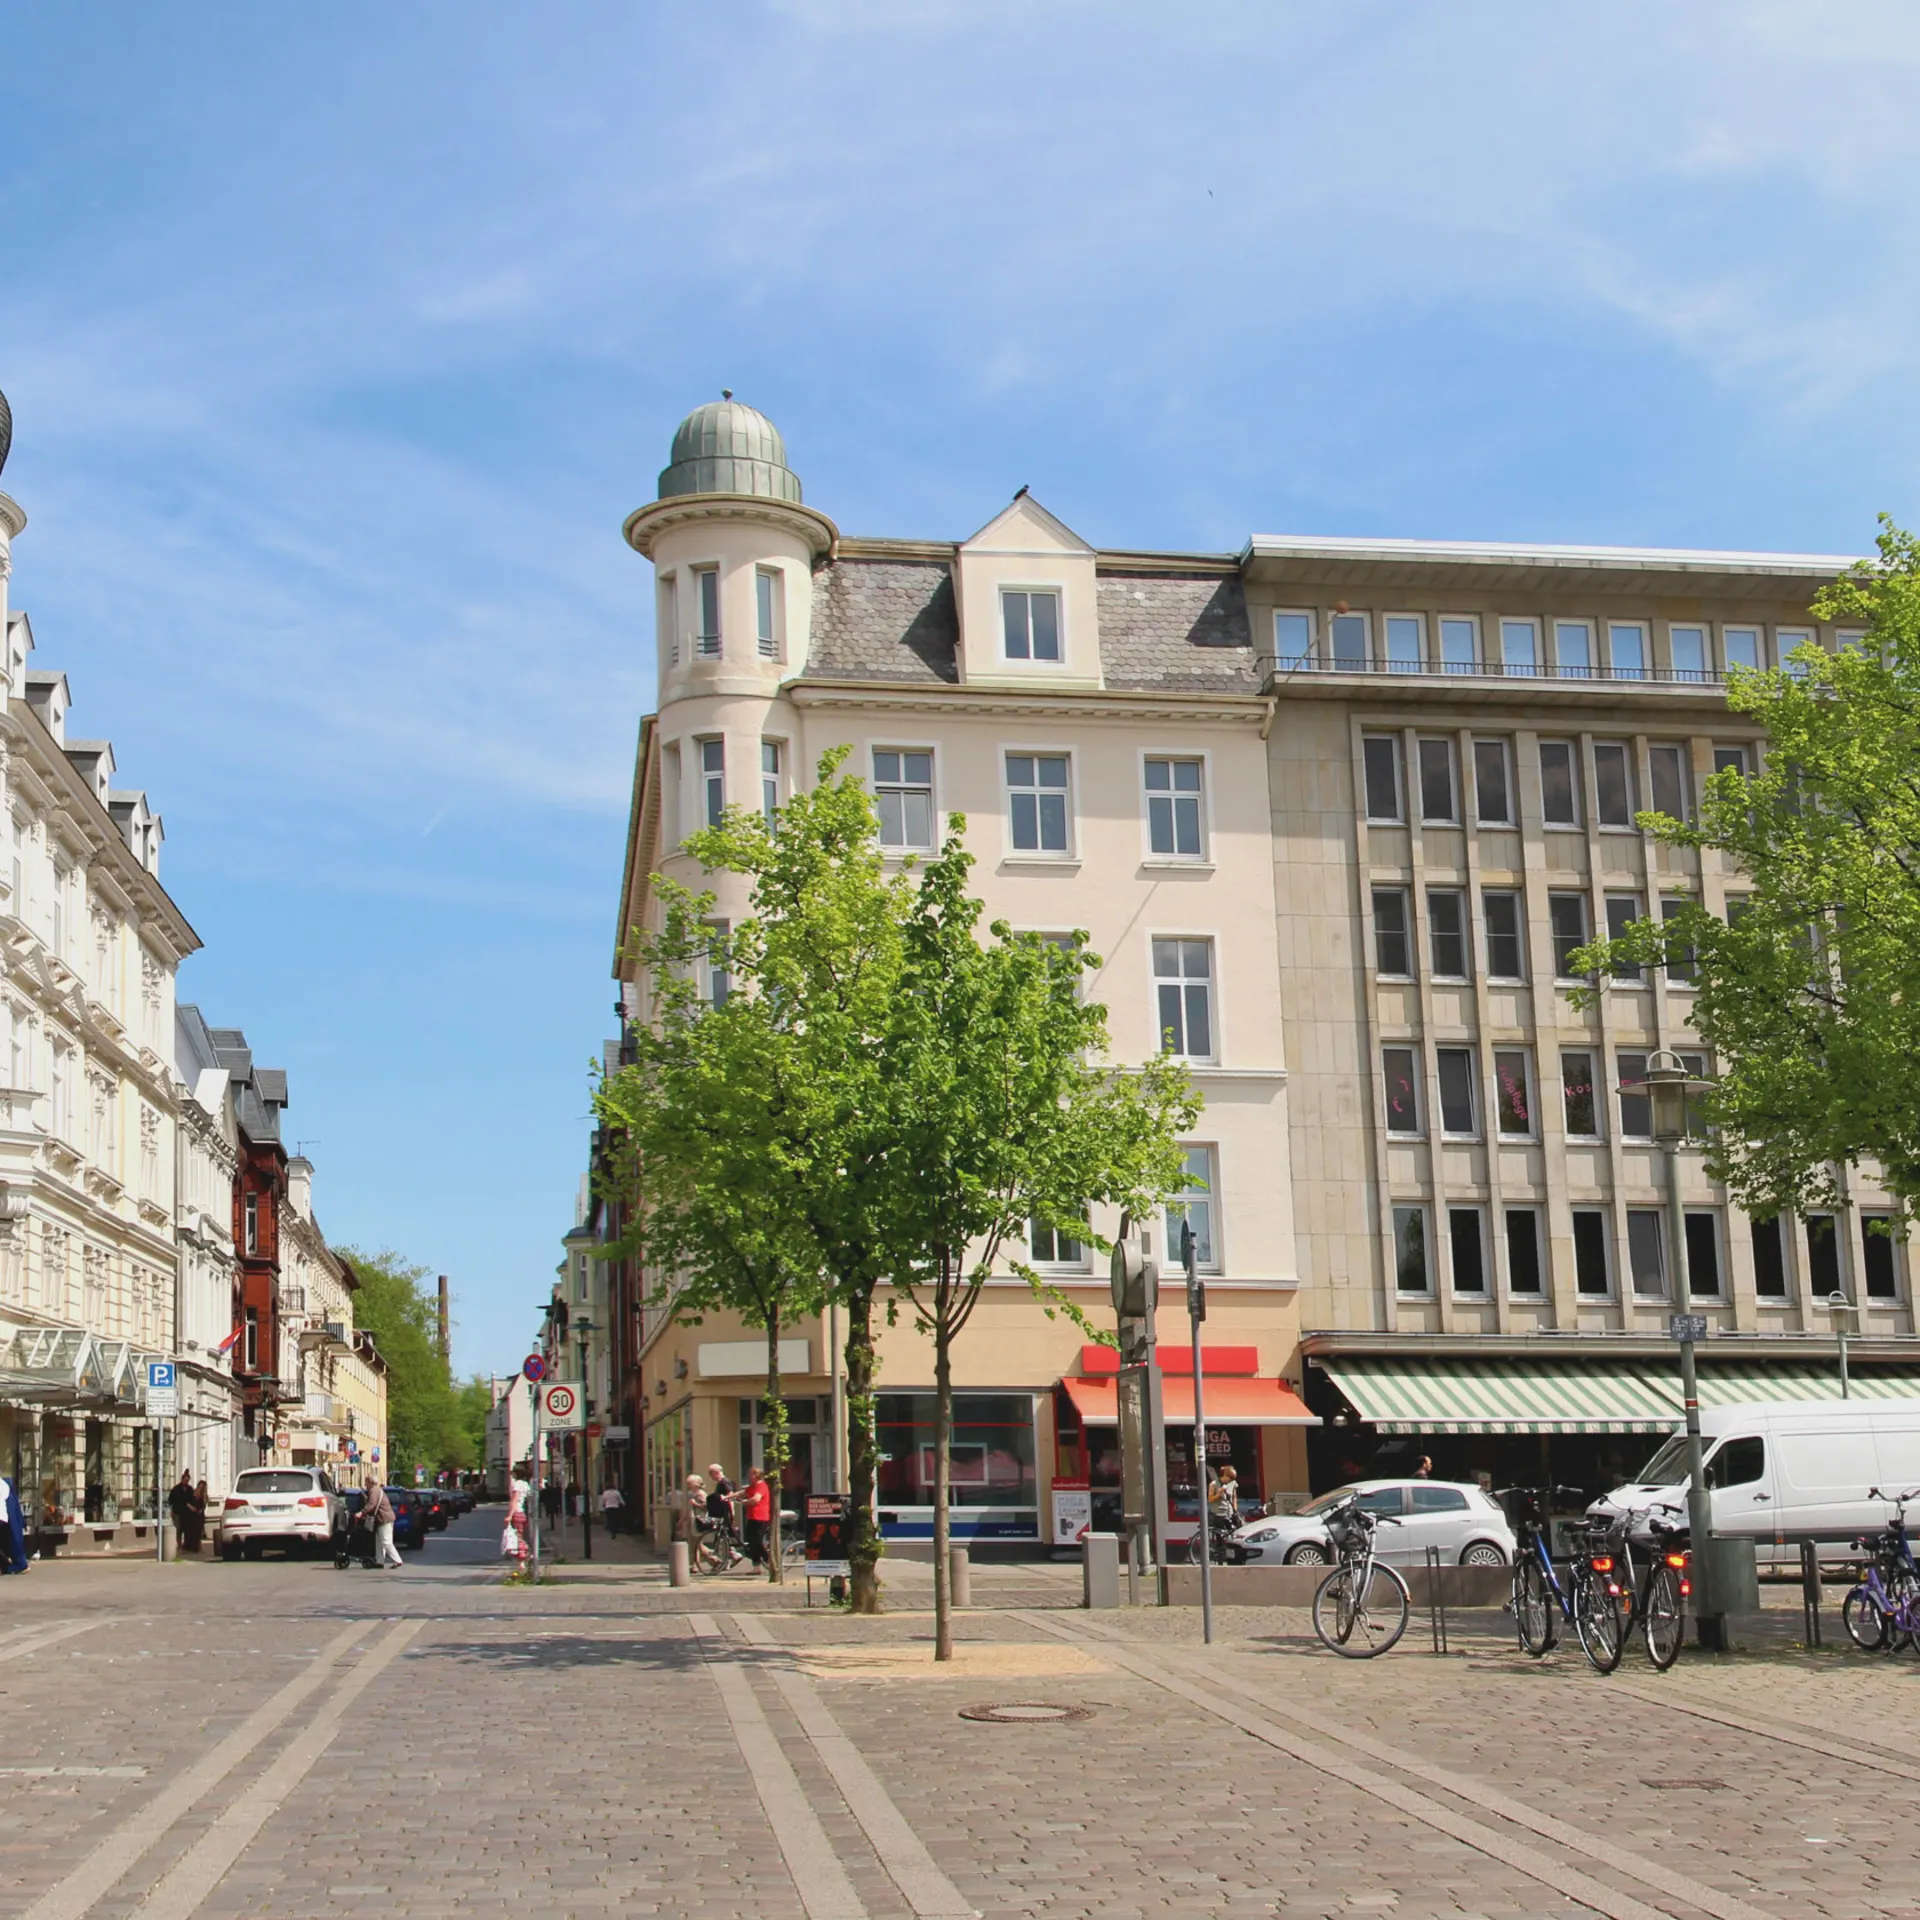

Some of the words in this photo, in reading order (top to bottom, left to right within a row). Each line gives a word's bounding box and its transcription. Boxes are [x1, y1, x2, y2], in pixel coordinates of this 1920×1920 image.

[154, 1366, 168, 1385] P
[551, 1394, 569, 1409] 30
[549, 1417, 572, 1426] ZONE
